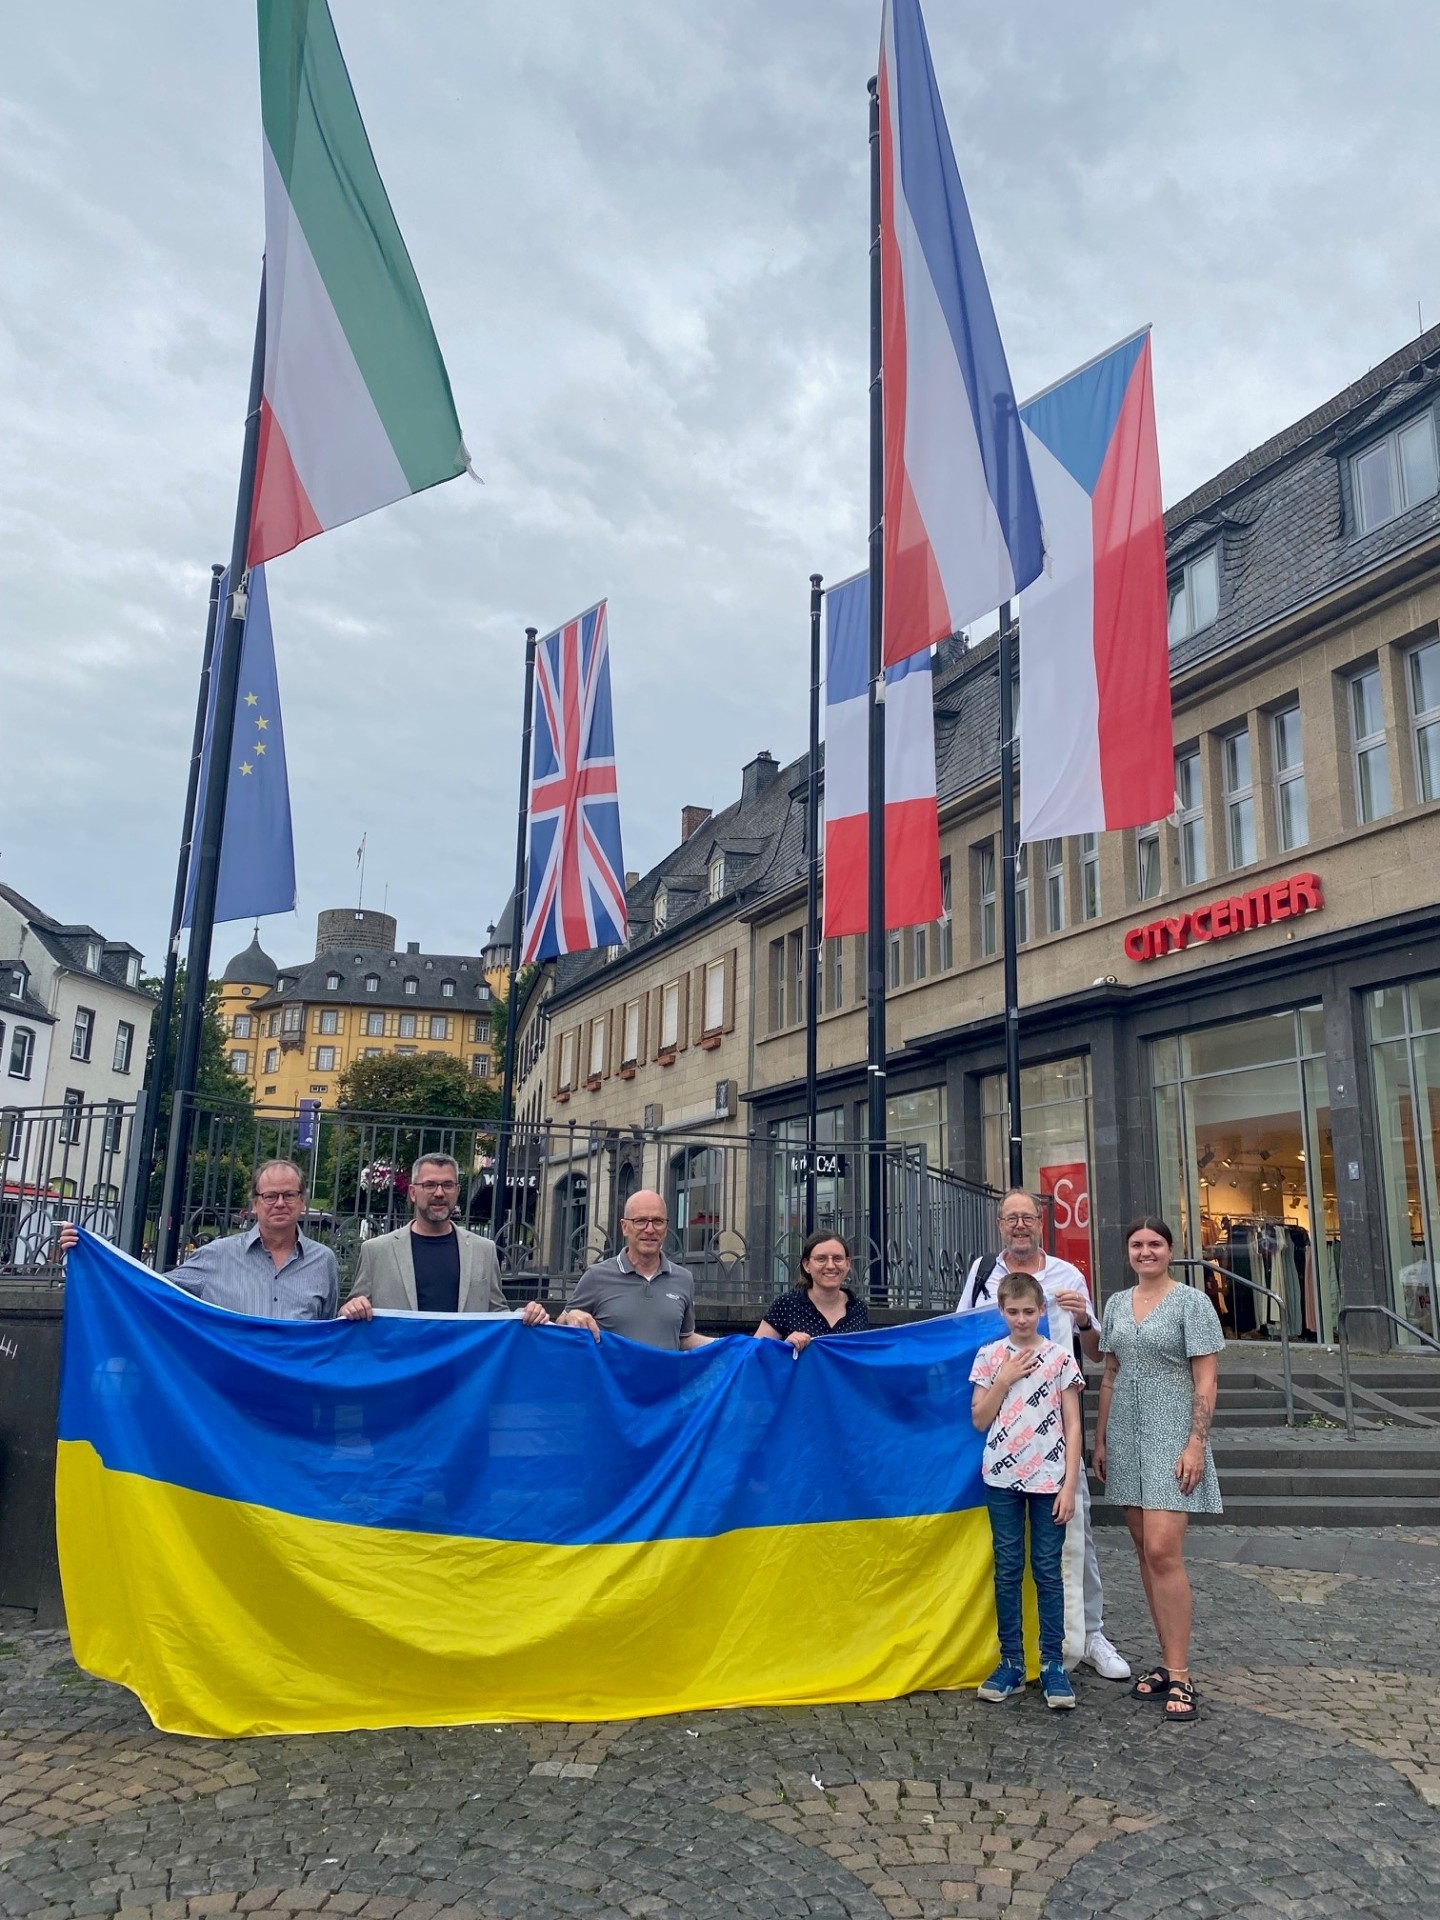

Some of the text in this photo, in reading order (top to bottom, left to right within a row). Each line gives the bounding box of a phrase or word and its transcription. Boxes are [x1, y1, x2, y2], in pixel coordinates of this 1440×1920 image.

[816, 1155, 841, 1173] C&A
[1032, 1381, 1050, 1405] PET
[1041, 1409, 1058, 1433] PET
[994, 1453, 1018, 1474] PET
